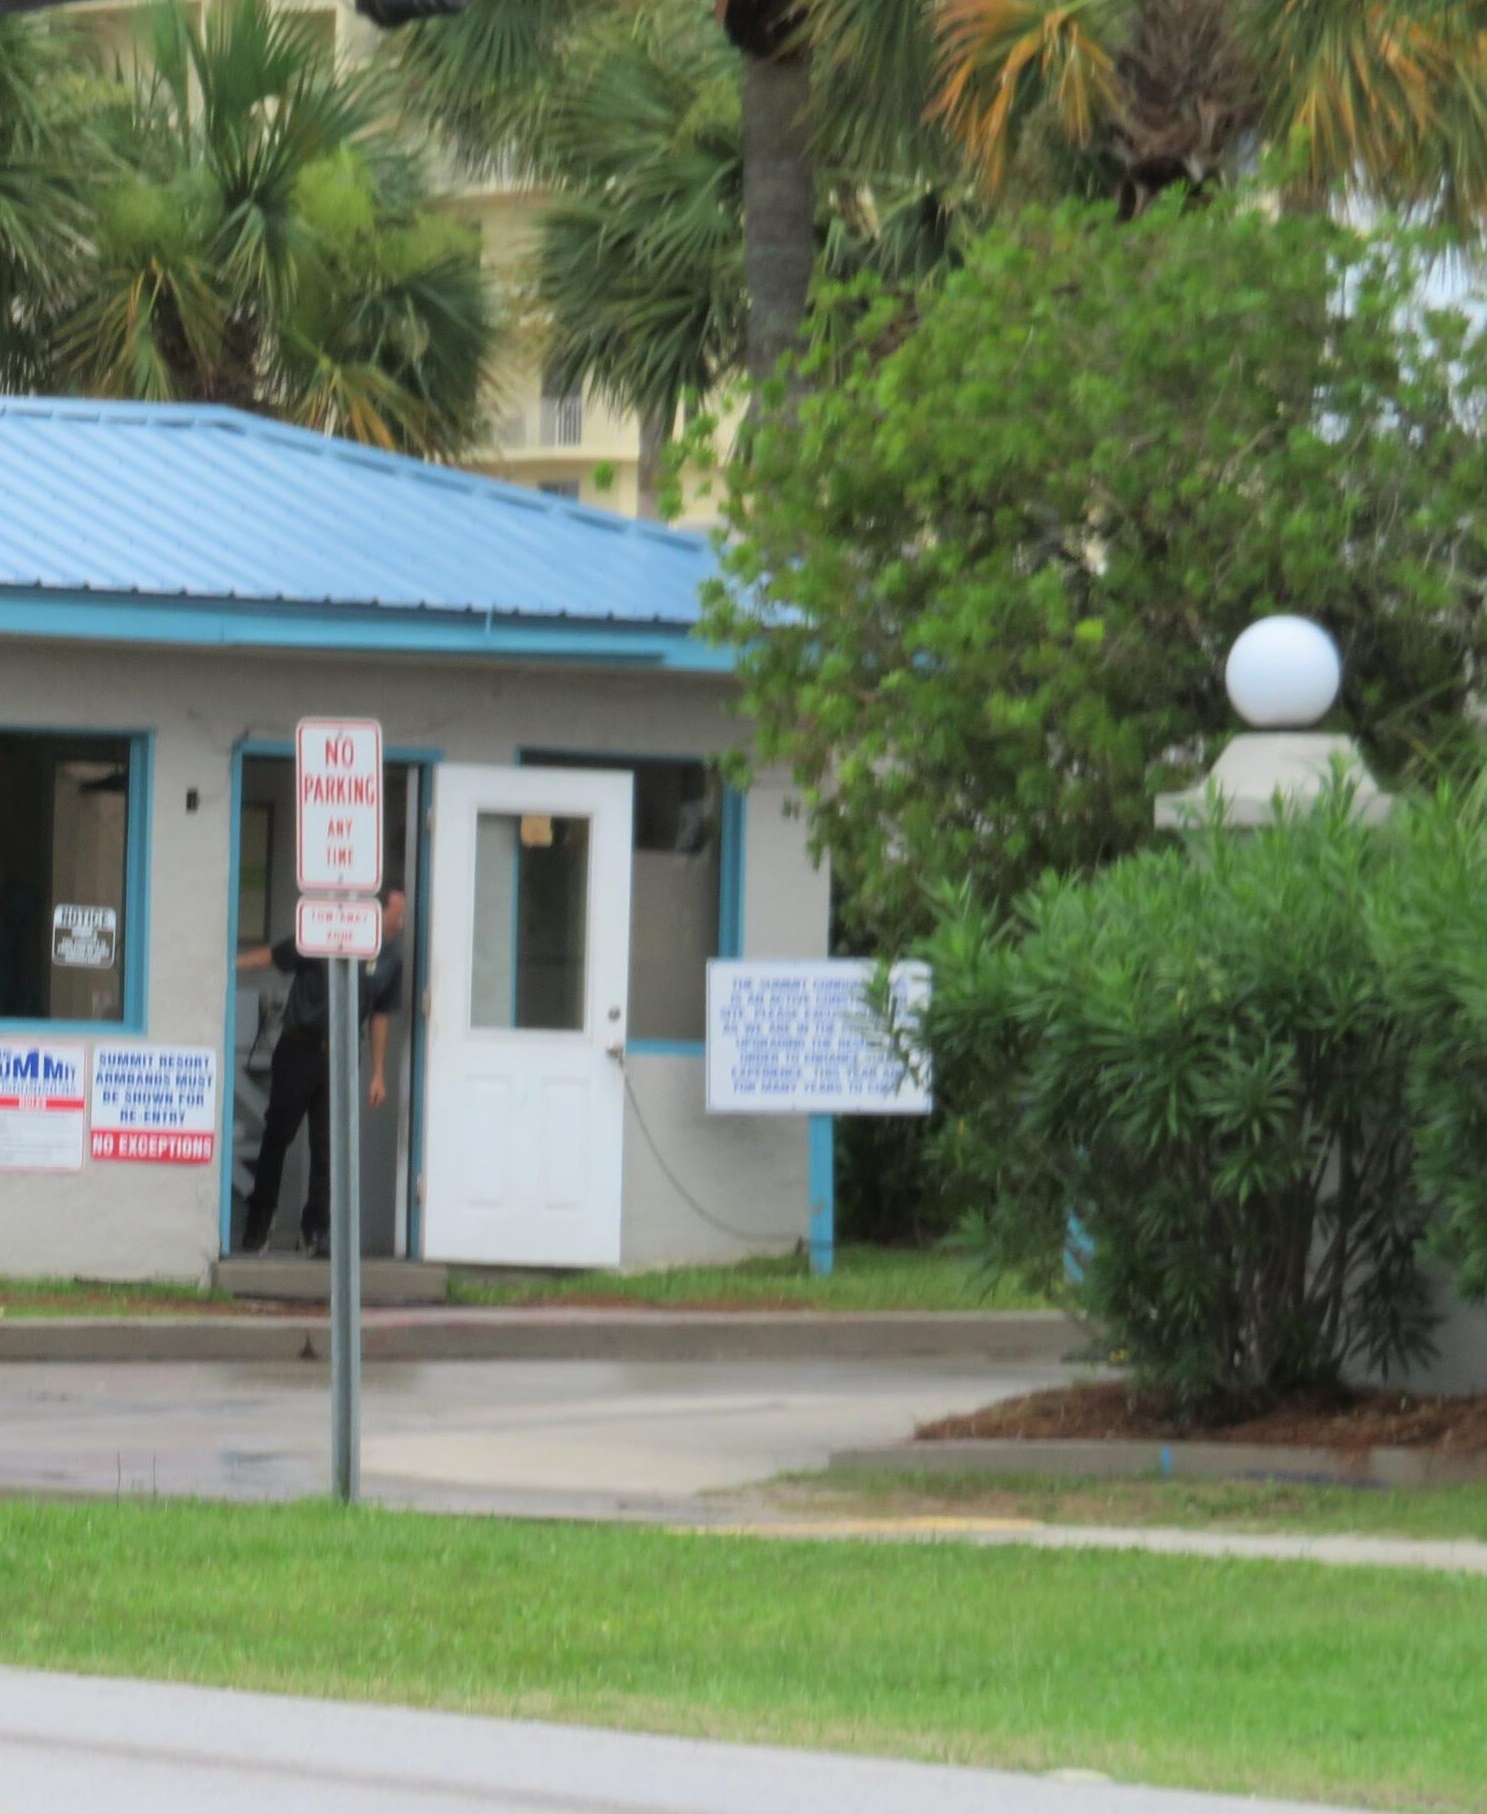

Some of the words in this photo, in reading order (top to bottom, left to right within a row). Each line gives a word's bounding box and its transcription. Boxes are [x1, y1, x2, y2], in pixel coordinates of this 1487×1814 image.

[324, 737, 355, 770] NO
[304, 775, 375, 807] PARKING
[327, 816, 353, 838] ANY
[326, 847, 354, 868] TIME
[61, 906, 106, 927] NOTICE
[99, 1051, 153, 1068] SUMMIT
[159, 1052, 210, 1069] RESORT
[95, 1072, 171, 1087] ARMBANDS
[175, 1073, 213, 1089] MUST
[102, 1091, 118, 1105] BE
[123, 1091, 173, 1107] SHOWN
[178, 1092, 205, 1108] FOR
[92, 1134, 115, 1155] NO
[119, 1135, 213, 1160] EXCEPTIONS
